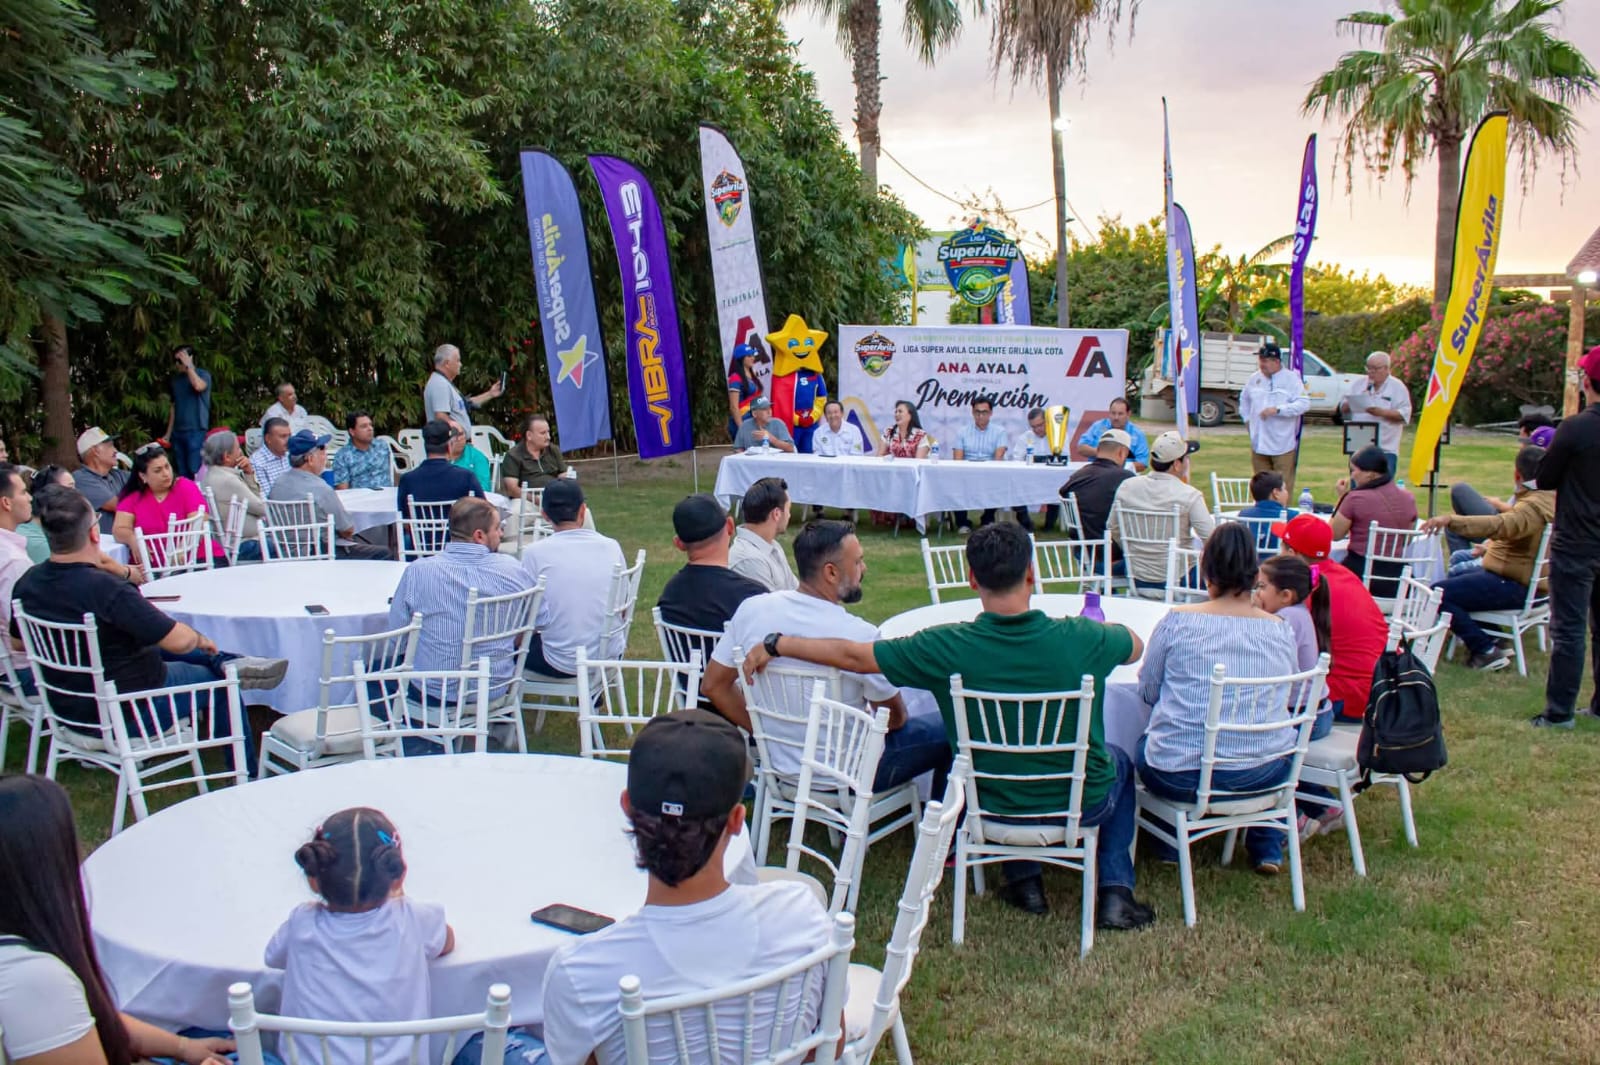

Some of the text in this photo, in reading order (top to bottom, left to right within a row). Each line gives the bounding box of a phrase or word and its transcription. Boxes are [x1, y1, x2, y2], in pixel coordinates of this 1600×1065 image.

[939, 241, 1017, 262] SuperÁvila
[1451, 193, 1498, 356] SuperÁvila
[620, 182, 673, 445] VIBRA 104.3
[903, 345, 1064, 356] LIGA SUPER AVILA CLEMENTE GRIJALVA COTA
[937, 362, 1028, 375] ANA AYALA
